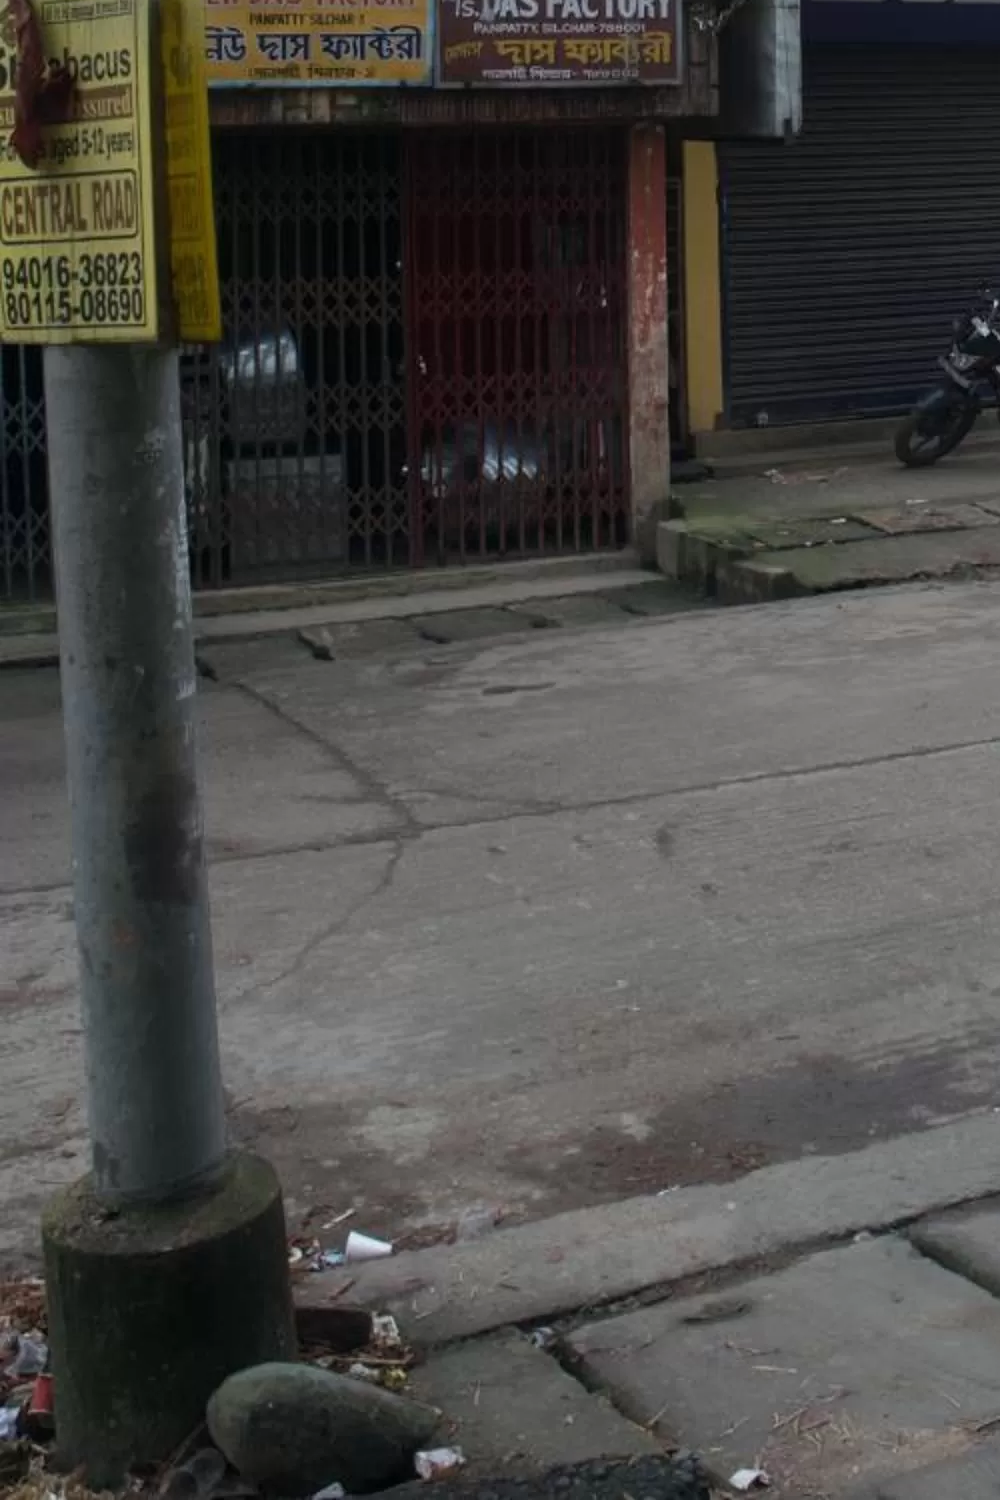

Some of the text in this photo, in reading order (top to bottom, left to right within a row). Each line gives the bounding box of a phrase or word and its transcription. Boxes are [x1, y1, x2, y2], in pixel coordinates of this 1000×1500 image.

[256, 33, 311, 61] দাস
[493, 38, 557, 65] দাস
[76, 86, 132, 119] ssured
[2, 181, 88, 237] CENTRAL
[92, 178, 136, 231] ROAD
[3, 251, 142, 290] 94016-36823
[7, 287, 144, 325] 80115-08690
